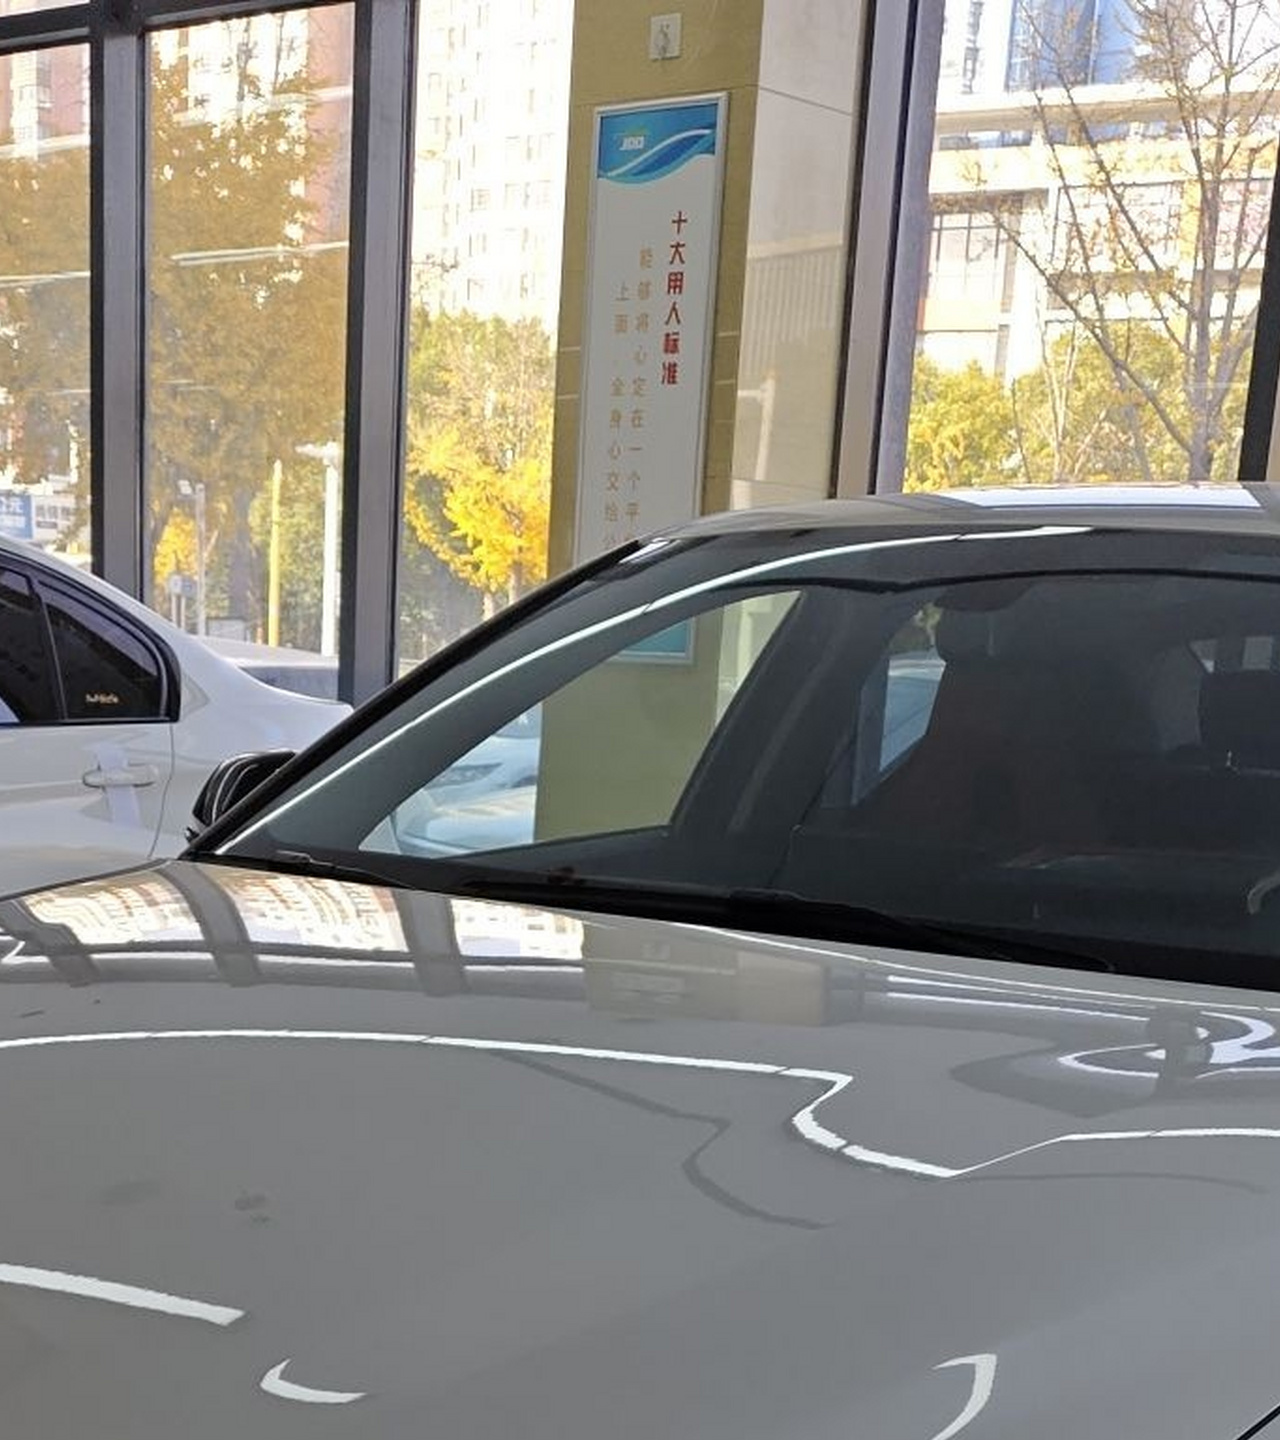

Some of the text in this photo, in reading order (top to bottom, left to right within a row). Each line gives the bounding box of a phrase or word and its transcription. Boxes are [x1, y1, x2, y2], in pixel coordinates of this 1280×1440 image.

[661, 210, 688, 386] 十大用人标准
